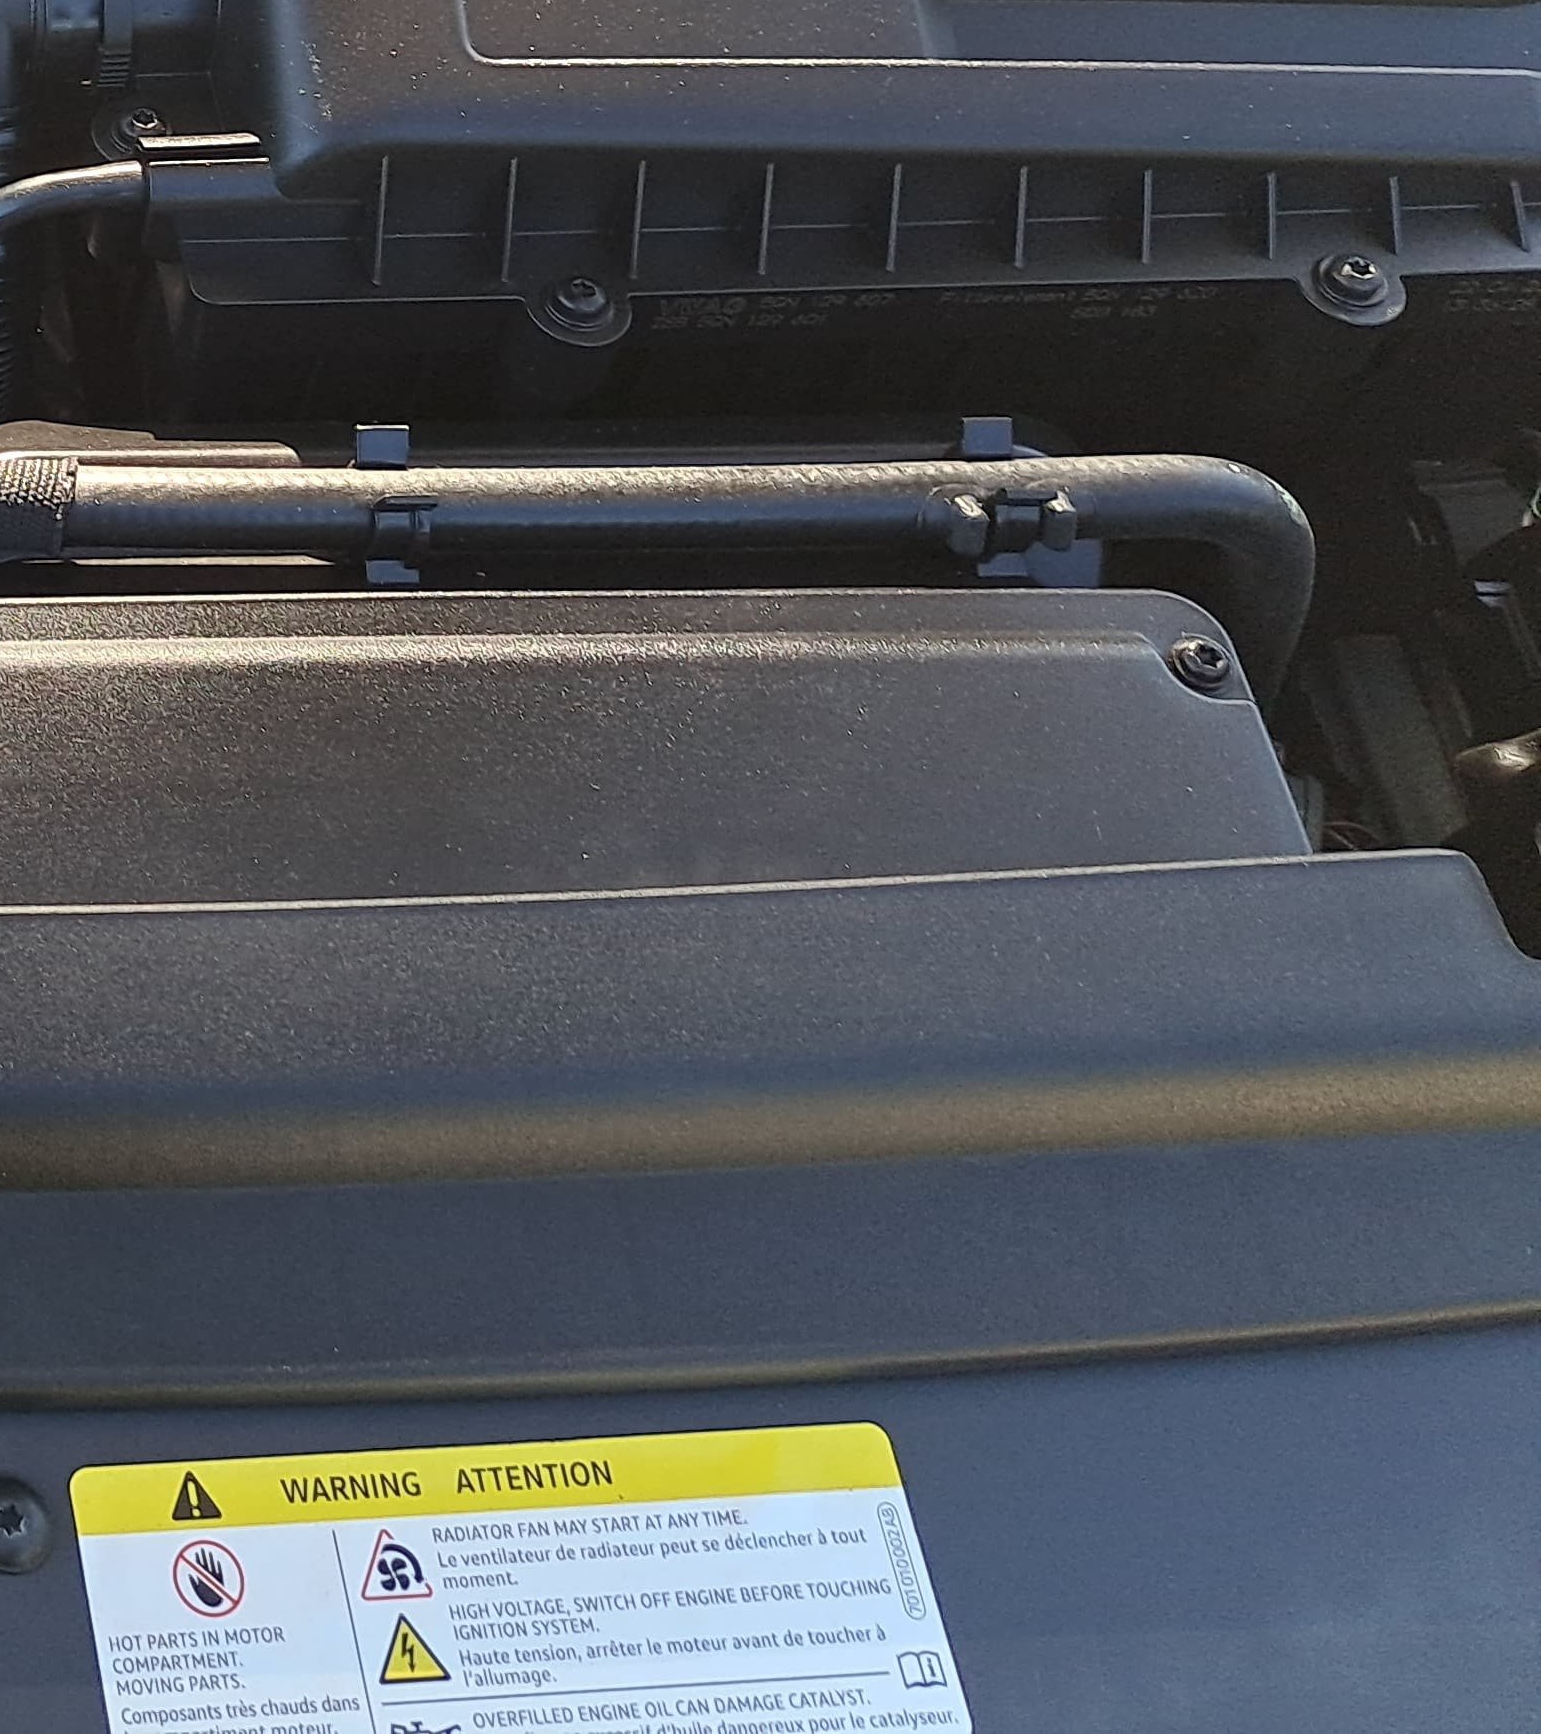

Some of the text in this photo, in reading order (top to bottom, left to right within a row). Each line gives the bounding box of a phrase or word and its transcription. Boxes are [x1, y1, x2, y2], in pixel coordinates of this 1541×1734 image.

[280, 1460, 614, 1504] WARNING ATTENTION
[432, 1508, 748, 1543] RADIATOR FAN MAY START AT ANY TIME.
[437, 1527, 867, 1568] Le ventilateur de radiateur peut se déclencher à tout
[442, 1571, 519, 1589] moment.
[448, 1577, 892, 1621] HIGH VOLTAGE, SWITCH OFF ENGINE BEFORE TOUCHING
[109, 1626, 285, 1652] HOT PARTS IN MOTOR
[453, 1616, 600, 1641] IGNITION SYSTEM.
[459, 1624, 887, 1667] Haute tension, arrêter le moteur avant de toucher à
[113, 1652, 243, 1674] COMPARTMENT.
[117, 1673, 246, 1696] MOVING PARTS.
[464, 1667, 558, 1689] l'allumage.
[122, 1694, 360, 1726] Composants très chauds dans
[473, 1689, 872, 1728] OVERFILLED ENGINE OIL CAN DAMAGE CATALYST.
[849, 1709, 959, 1730] le catalyseur.
